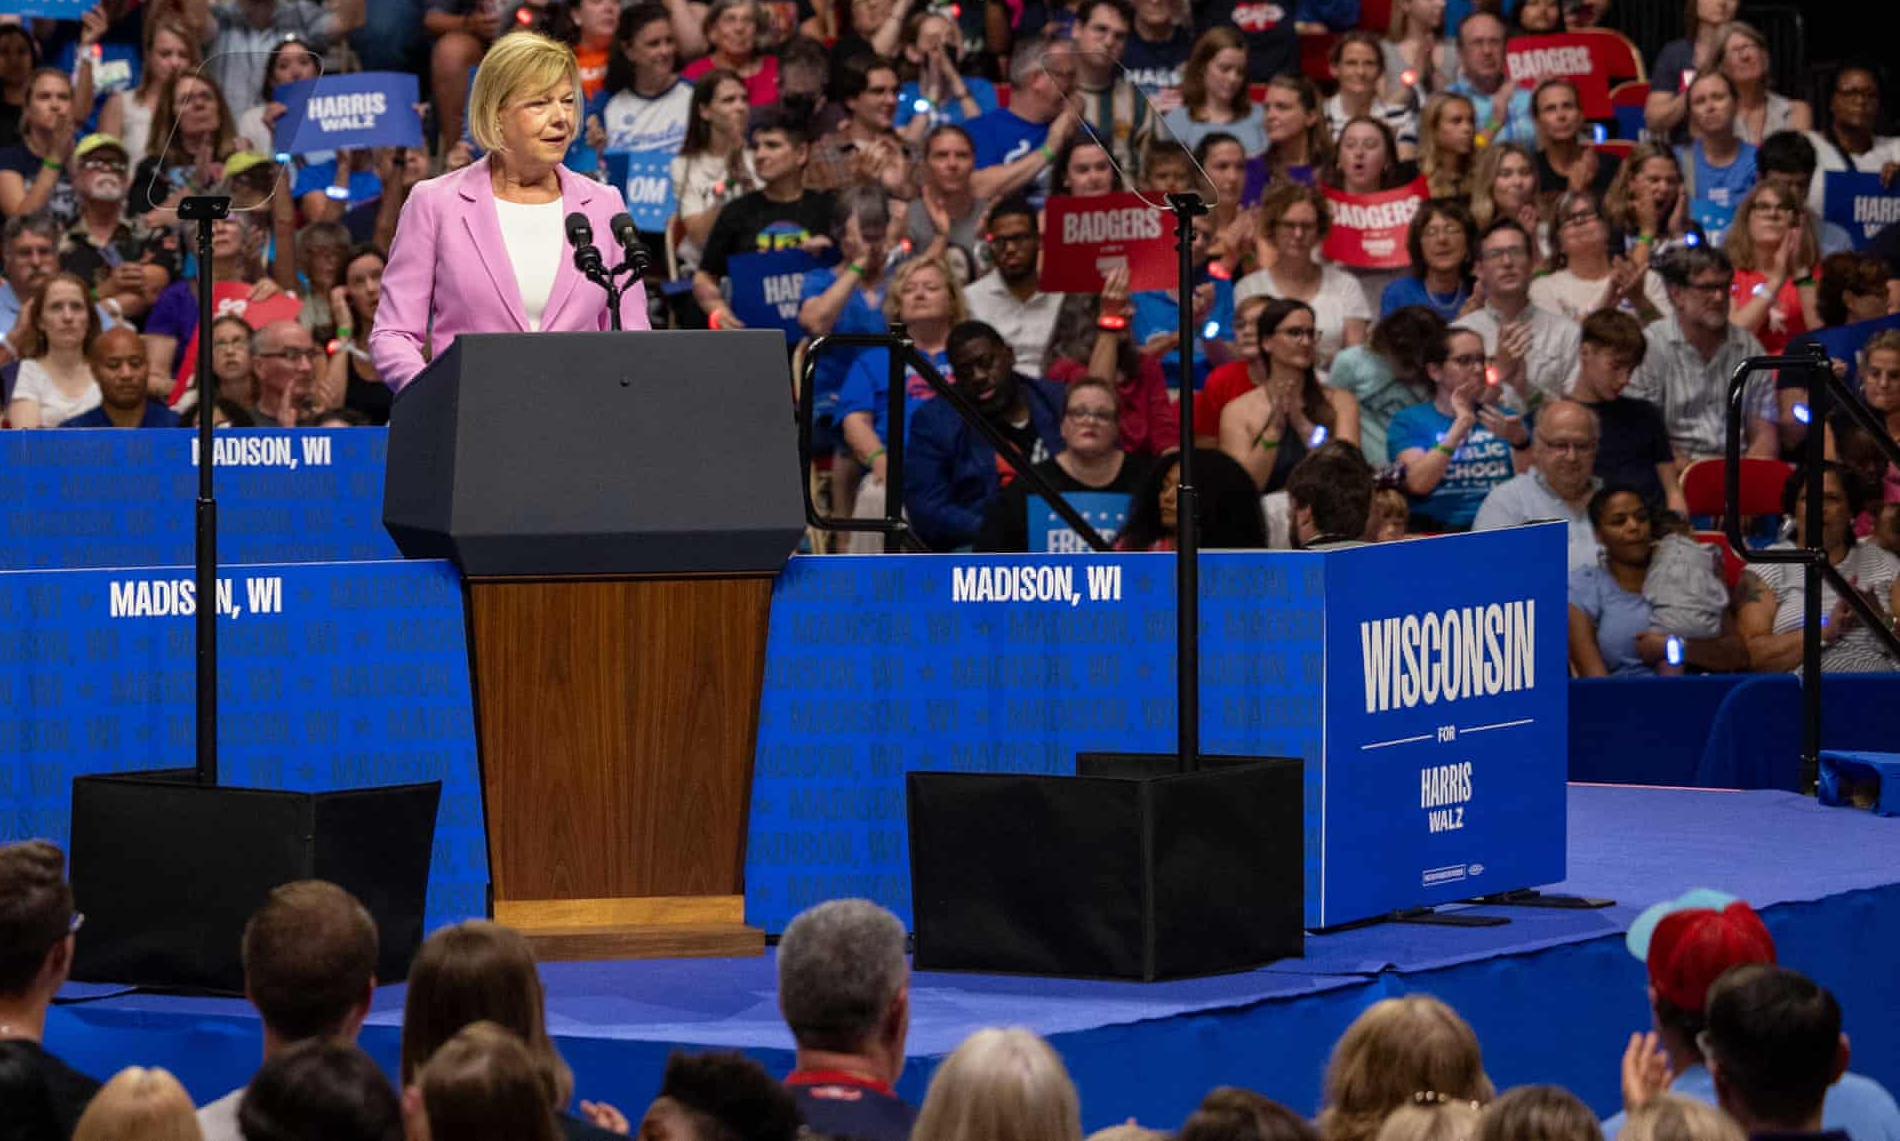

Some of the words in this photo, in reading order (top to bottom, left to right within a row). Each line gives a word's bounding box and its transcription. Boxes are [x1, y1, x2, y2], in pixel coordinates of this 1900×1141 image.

[1506, 45, 1593, 79] BADGERS
[307, 92, 387, 120] HARRIS
[319, 114, 377, 132] WALZ
[1063, 209, 1162, 244] BADGERS
[190, 436, 299, 470] ADISON,
[301, 435, 333, 466] WI
[110, 578, 241, 619] MADISN,
[247, 576, 283, 614] WI
[951, 566, 1081, 606] MADISON,
[1087, 565, 1122, 602] WI
[1361, 599, 1535, 714] WISCONSIN
[1437, 724, 1456, 743] FOR
[1421, 761, 1473, 810] HARRIS
[1428, 809, 1464, 835] WALZ
